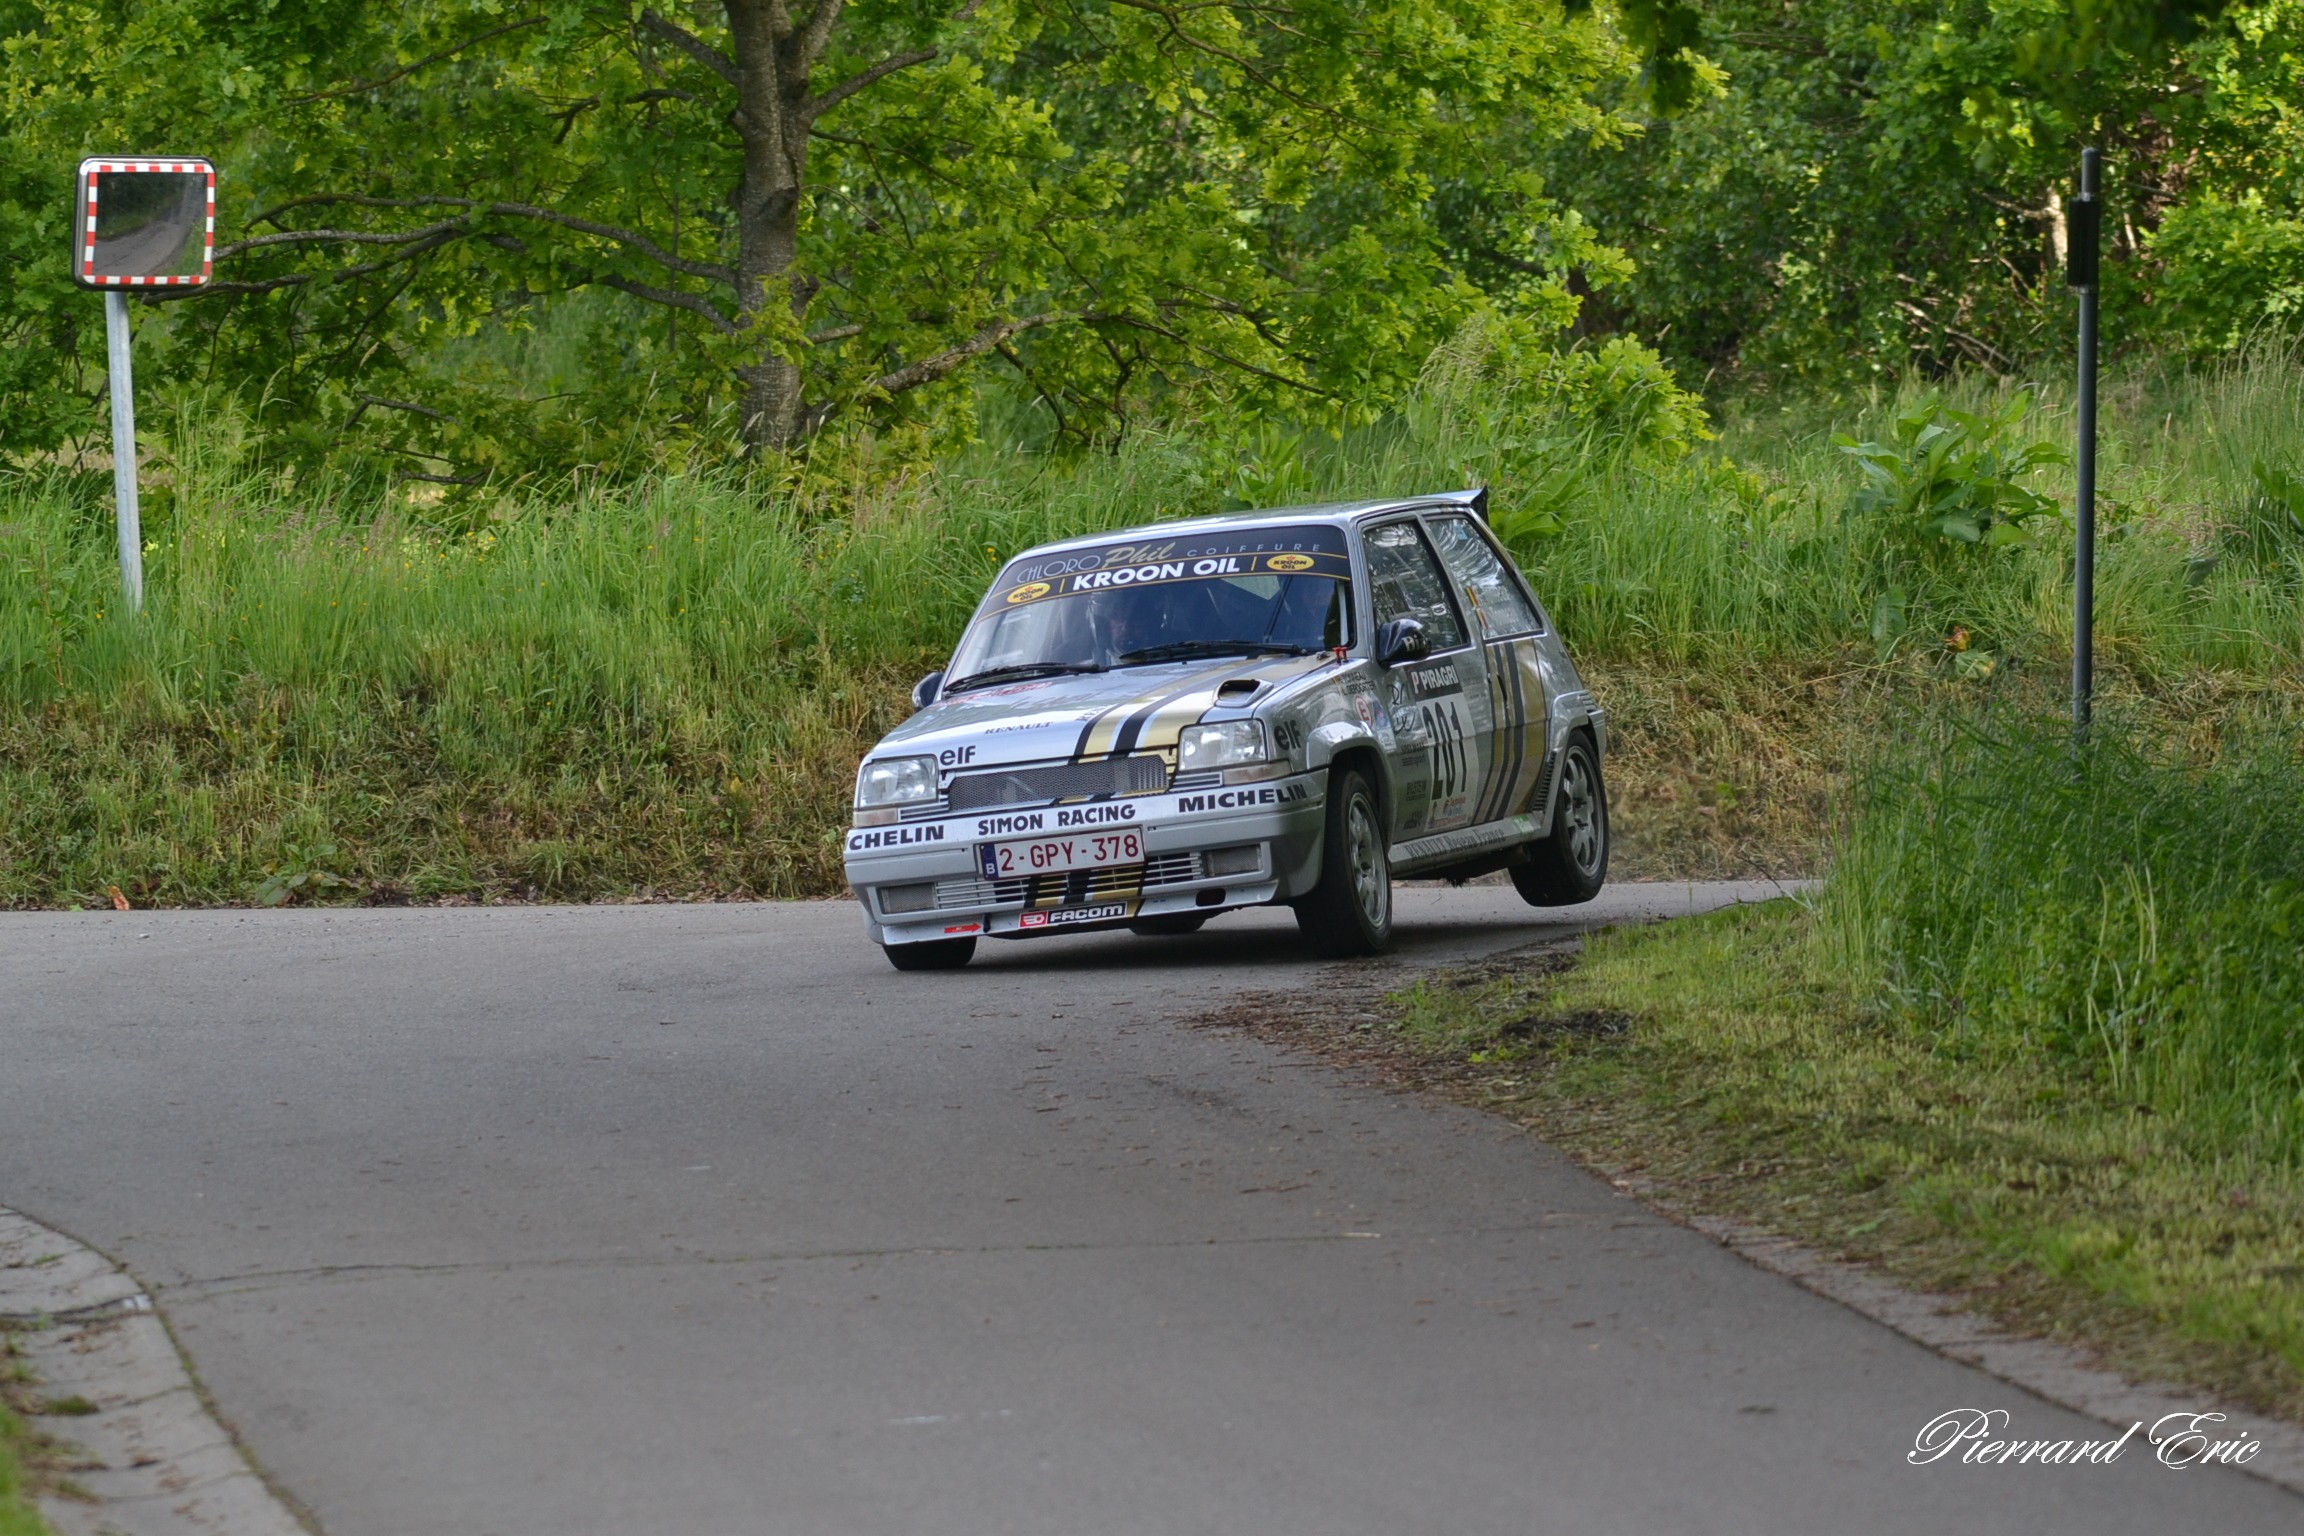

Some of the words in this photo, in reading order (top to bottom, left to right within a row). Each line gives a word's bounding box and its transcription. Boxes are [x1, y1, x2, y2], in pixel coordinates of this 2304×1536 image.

[1016, 555, 1101, 583] CHLORO
[1102, 542, 1177, 570] Phil
[1187, 543, 1320, 558] COIFFURE
[1073, 560, 1183, 591] KROON
[1193, 556, 1240, 578] OIL
[1419, 664, 1459, 691] PIRAGRI
[984, 720, 1053, 735] RENAULT
[1273, 719, 1302, 751] elf
[939, 745, 976, 767] elf
[1421, 701, 1467, 801] 201
[1178, 783, 1308, 813] MICHELIN
[978, 813, 1043, 836] SIMON
[1057, 804, 1136, 827] RACING
[849, 825, 944, 851] CHELIN
[985, 863, 996, 875] B
[1050, 904, 1123, 923] FACOM
